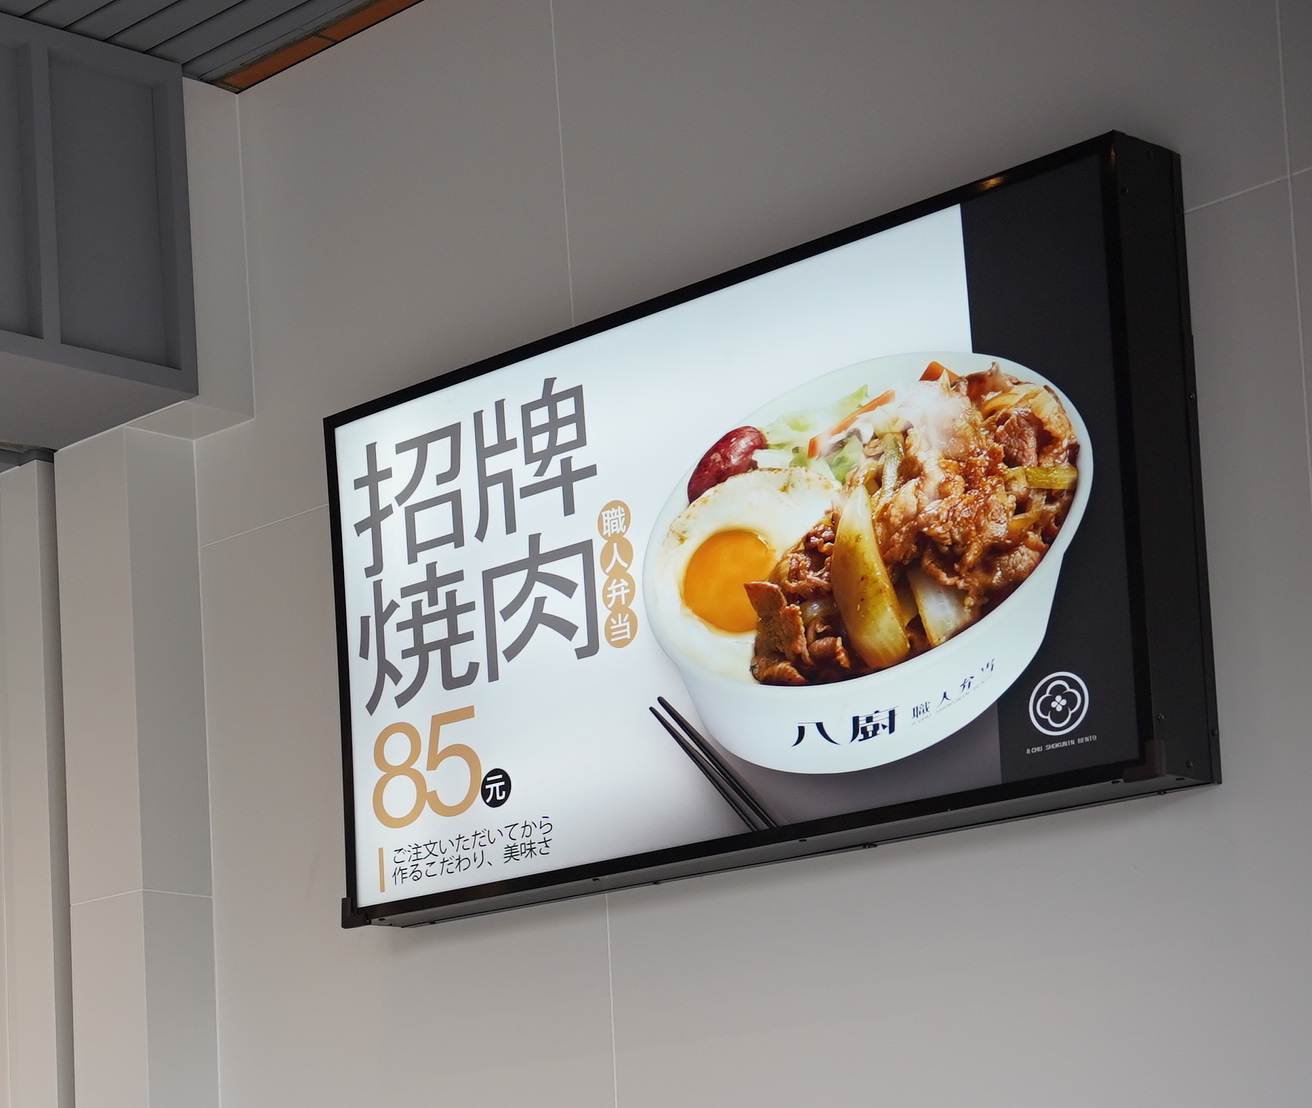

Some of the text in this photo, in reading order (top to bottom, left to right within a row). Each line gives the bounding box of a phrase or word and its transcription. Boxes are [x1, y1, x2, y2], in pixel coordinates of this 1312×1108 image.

[353, 377, 598, 578] 招牌
[359, 532, 600, 716] 焼肉
[601, 505, 633, 645] 職人弁当
[372, 705, 507, 829] 85 元
[791, 705, 899, 747] 八廚
[393, 815, 553, 864] ご注文いただいてから
